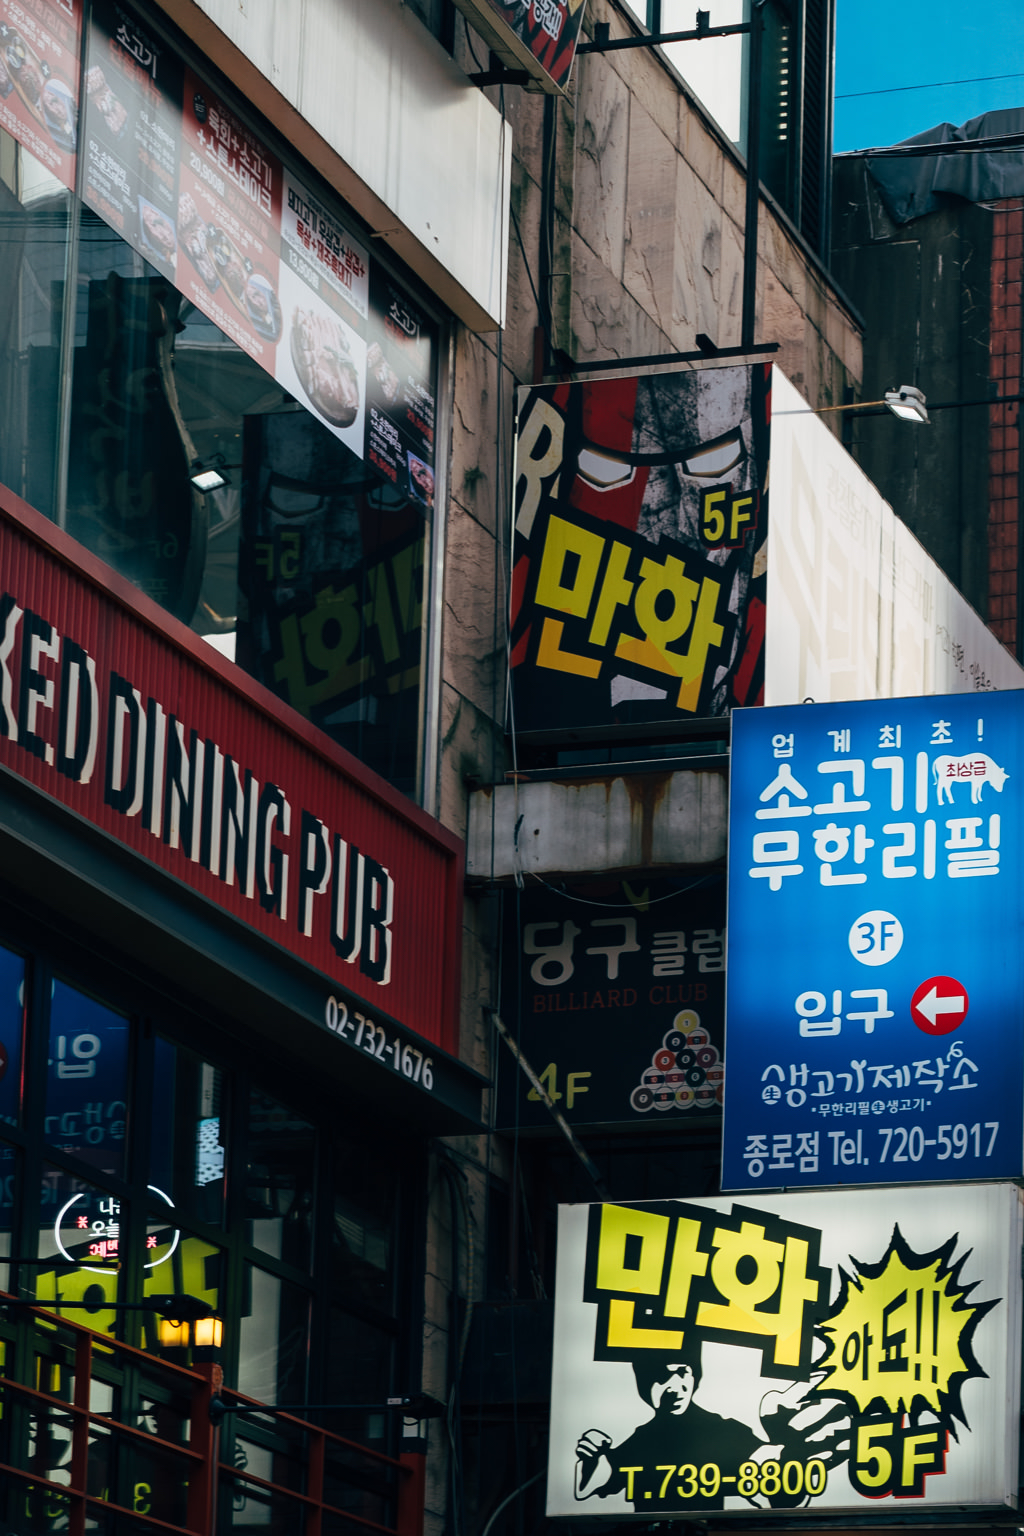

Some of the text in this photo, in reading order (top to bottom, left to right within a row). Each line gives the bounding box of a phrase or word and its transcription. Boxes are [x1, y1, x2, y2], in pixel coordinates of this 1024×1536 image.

[703, 490, 754, 543] 5F
[534, 513, 725, 713] 만화
[755, 751, 928, 820] 소고기
[945, 760, 987, 777] 최상급
[102, 670, 394, 987] DINING PUB
[748, 813, 1001, 892] 무한리필
[856, 920, 896, 954] 3F
[533, 983, 708, 1014] BILLIARD CLUB
[794, 987, 895, 1038] 입구
[323, 994, 435, 1091] 02-732-1676
[527, 1062, 592, 1110] 4F
[742, 1121, 1000, 1179] 종로점 Tel. 720-5917
[596, 1203, 819, 1367] 만화
[618, 1457, 828, 1501] T.739-8800
[857, 1421, 939, 1490] 5F
